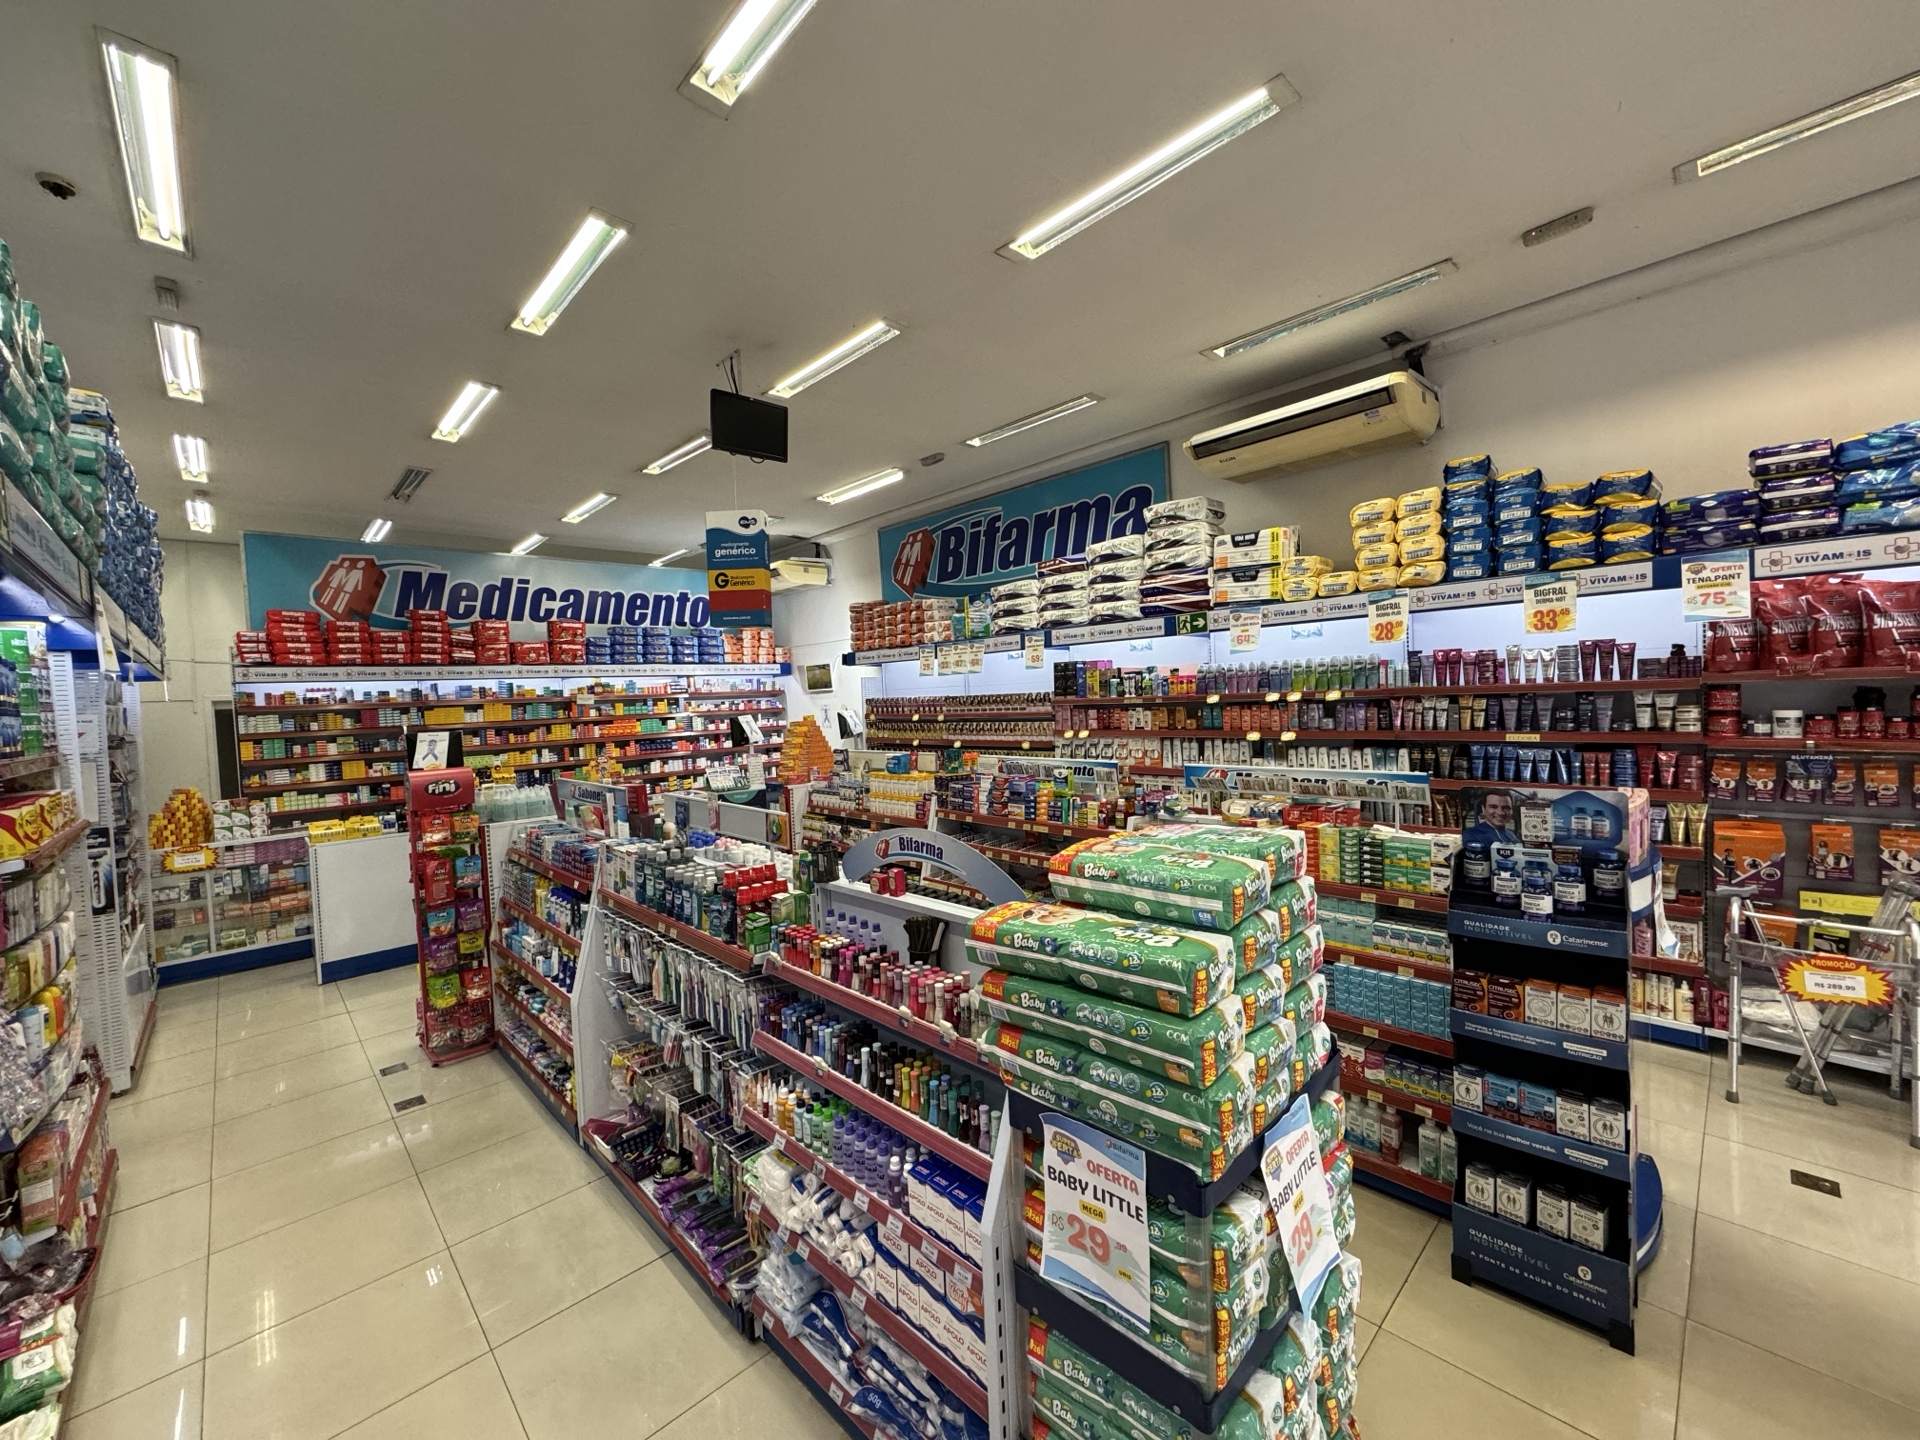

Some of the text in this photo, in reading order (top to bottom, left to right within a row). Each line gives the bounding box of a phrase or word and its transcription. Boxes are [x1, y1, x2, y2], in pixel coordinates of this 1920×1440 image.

[936, 485, 1152, 583] Bifarma
[715, 546, 756, 557] genérico
[1710, 564, 1744, 573] OFERTA
[394, 571, 710, 628] Medicamento
[1534, 587, 1568, 598] BIGFRAL
[1699, 592, 1726, 605] 75
[1376, 602, 1402, 612] BIGFRAL
[428, 780, 456, 794] Fini
[898, 836, 944, 860] Bifarma
[1084, 862, 1111, 880] Baby
[1198, 884, 1217, 894] CCM
[1464, 920, 1510, 930] QUALIDADE
[1013, 932, 1039, 950] Baby
[1562, 934, 1608, 947] Catarinense
[1158, 958, 1182, 970] CCM
[1810, 959, 1856, 970] PROMOÇÃO
[1454, 978, 1482, 988] CITRUSEC
[1488, 984, 1517, 994] CITRUSEC
[1020, 992, 1046, 1012] Baby
[1166, 1030, 1191, 1042] CCM
[1526, 1035, 1556, 1046] Alimentares
[1035, 1049, 1060, 1070] Baby
[1204, 1056, 1215, 1064] 30
[1204, 1068, 1216, 1077] 26
[1030, 1083, 1056, 1104] Baby
[1182, 1092, 1205, 1106] CCM
[1558, 1106, 1584, 1116] ANTIOX
[1055, 1134, 1075, 1149] SUPER
[1466, 1122, 1482, 1131] Você
[1494, 1130, 1504, 1138] sua
[1506, 1134, 1530, 1146] melhor
[1050, 1139, 1082, 1159] OFERTAS
[1112, 1142, 1140, 1161] Bifarma
[1286, 1130, 1310, 1166] OFERTA
[1087, 1159, 1139, 1196] OFERTA
[1294, 1151, 1317, 1191] LITTLE
[910, 1193, 926, 1208] APOLO
[1047, 1165, 1144, 1225] BABY LITTLE
[926, 1204, 944, 1220] APOLO
[1082, 1204, 1104, 1220] MEGA
[1574, 1212, 1598, 1224] ANTIOX
[946, 1218, 964, 1234] APOLO
[883, 1232, 902, 1252] APOLO
[1052, 1213, 1111, 1265] R$ 29
[1290, 1212, 1313, 1267] 29
[1469, 1228, 1524, 1254] QUALIDADE
[916, 1259, 937, 1280] APOLO
[876, 1270, 895, 1290] APOLO
[1479, 1254, 1506, 1268] FONTE
[1509, 1266, 1520, 1274] DE
[1524, 1271, 1552, 1288] SAÚDE
[1556, 1284, 1568, 1294] DO
[1572, 1292, 1606, 1308] BRASIL
[1564, 1272, 1608, 1294] Catarinense
[899, 1287, 918, 1306] APOLO
[921, 1304, 941, 1325] APOLO
[944, 1324, 964, 1346] APOLO
[1063, 1359, 1090, 1387] Baby
[868, 1393, 882, 1408] 50g
[1052, 1400, 1078, 1429] Baby
